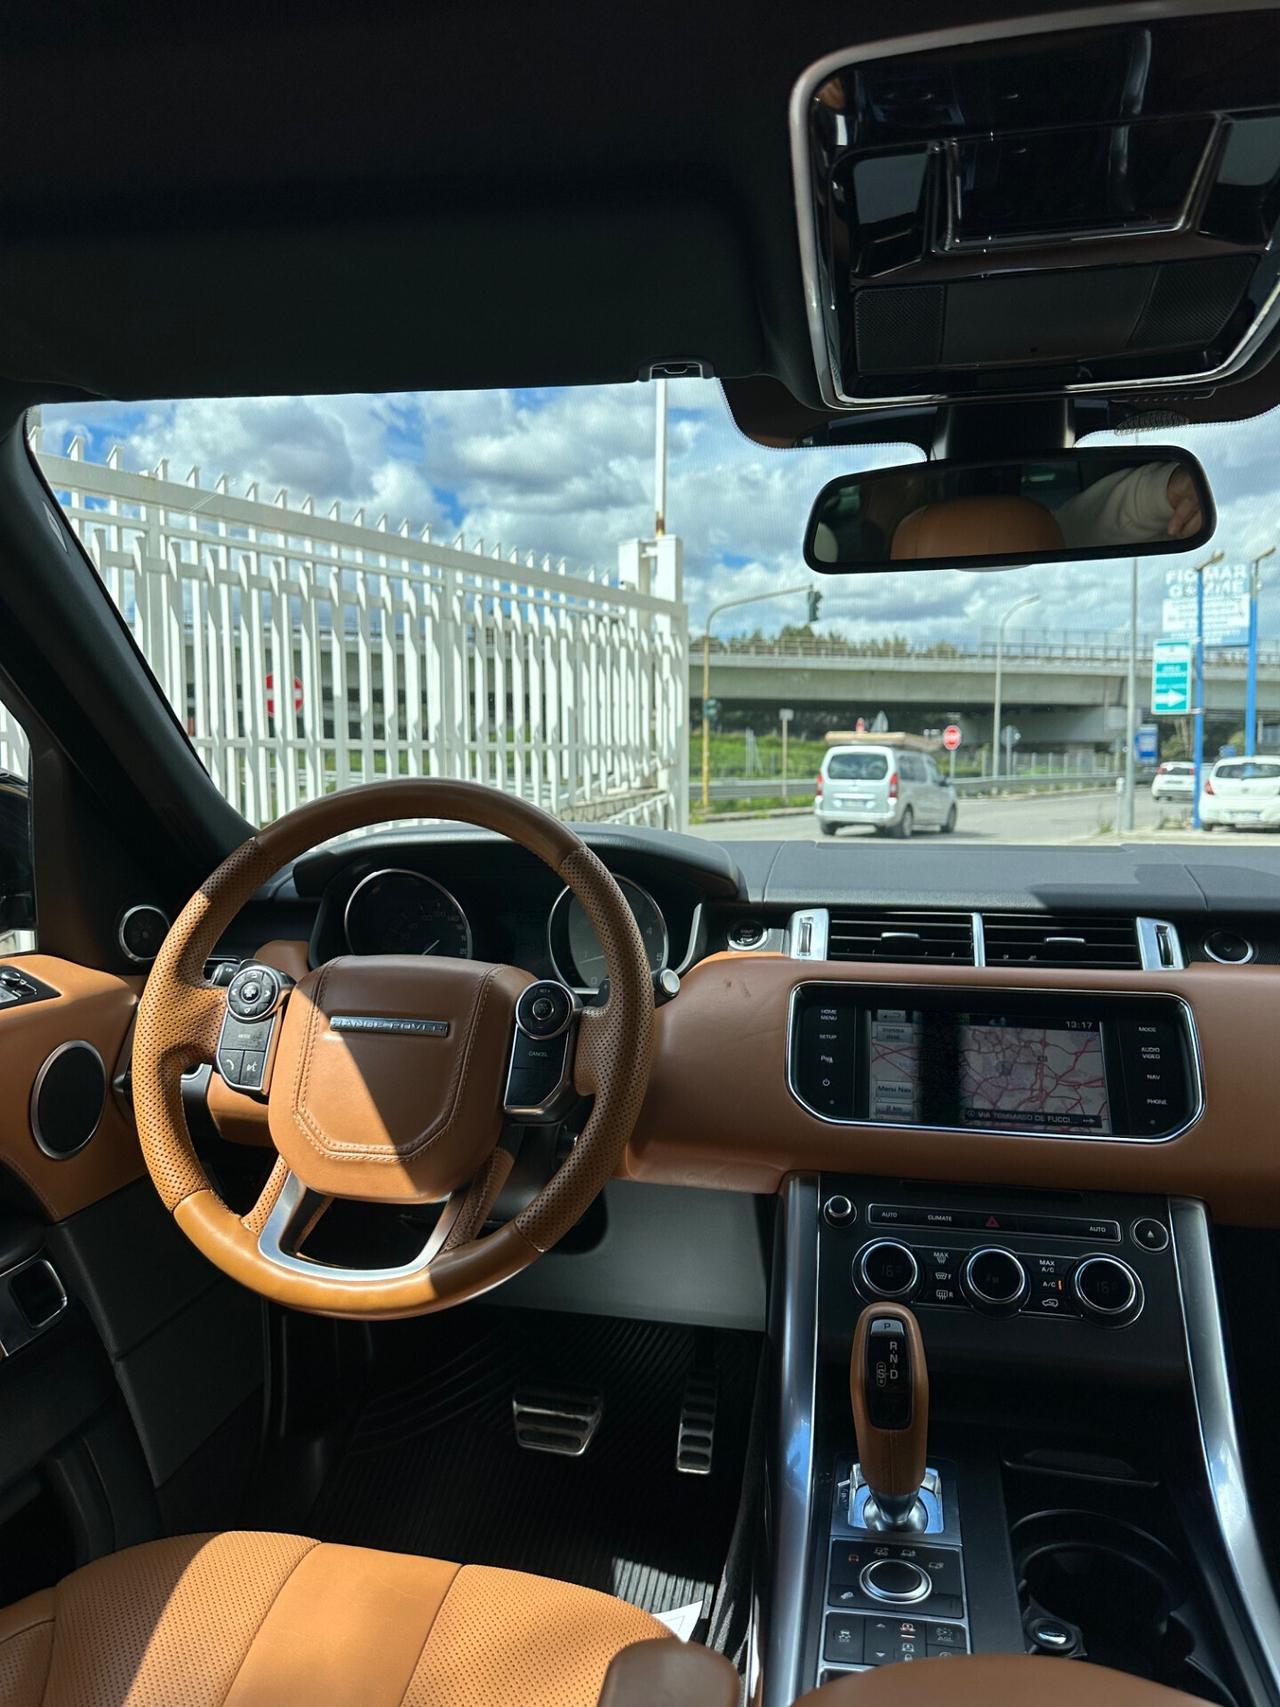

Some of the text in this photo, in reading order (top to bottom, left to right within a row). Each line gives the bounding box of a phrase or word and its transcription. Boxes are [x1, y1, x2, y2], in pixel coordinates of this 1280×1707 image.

[1065, 1020, 1093, 1029] 13:17
[927, 1214, 953, 1222] CLIMATE
[889, 1341, 898, 1350] R
[889, 1354, 898, 1364] N
[889, 1369, 898, 1379] D
